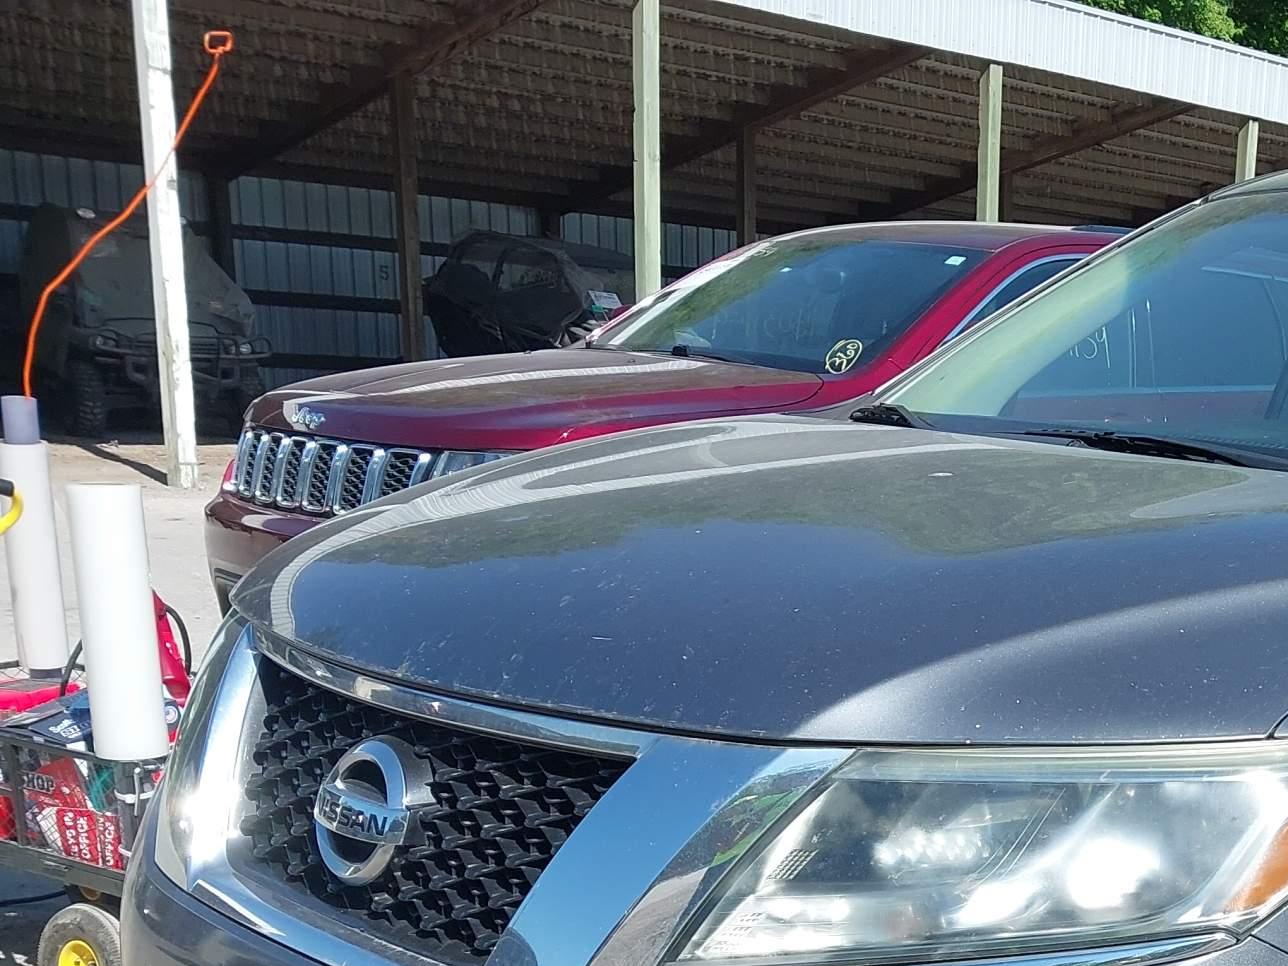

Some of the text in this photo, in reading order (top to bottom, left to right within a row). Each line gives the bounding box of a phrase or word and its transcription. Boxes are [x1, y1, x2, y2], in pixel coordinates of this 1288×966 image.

[379, 265, 389, 280] 5
[291, 404, 326, 429] Jeep
[318, 794, 388, 837] NISSAN
